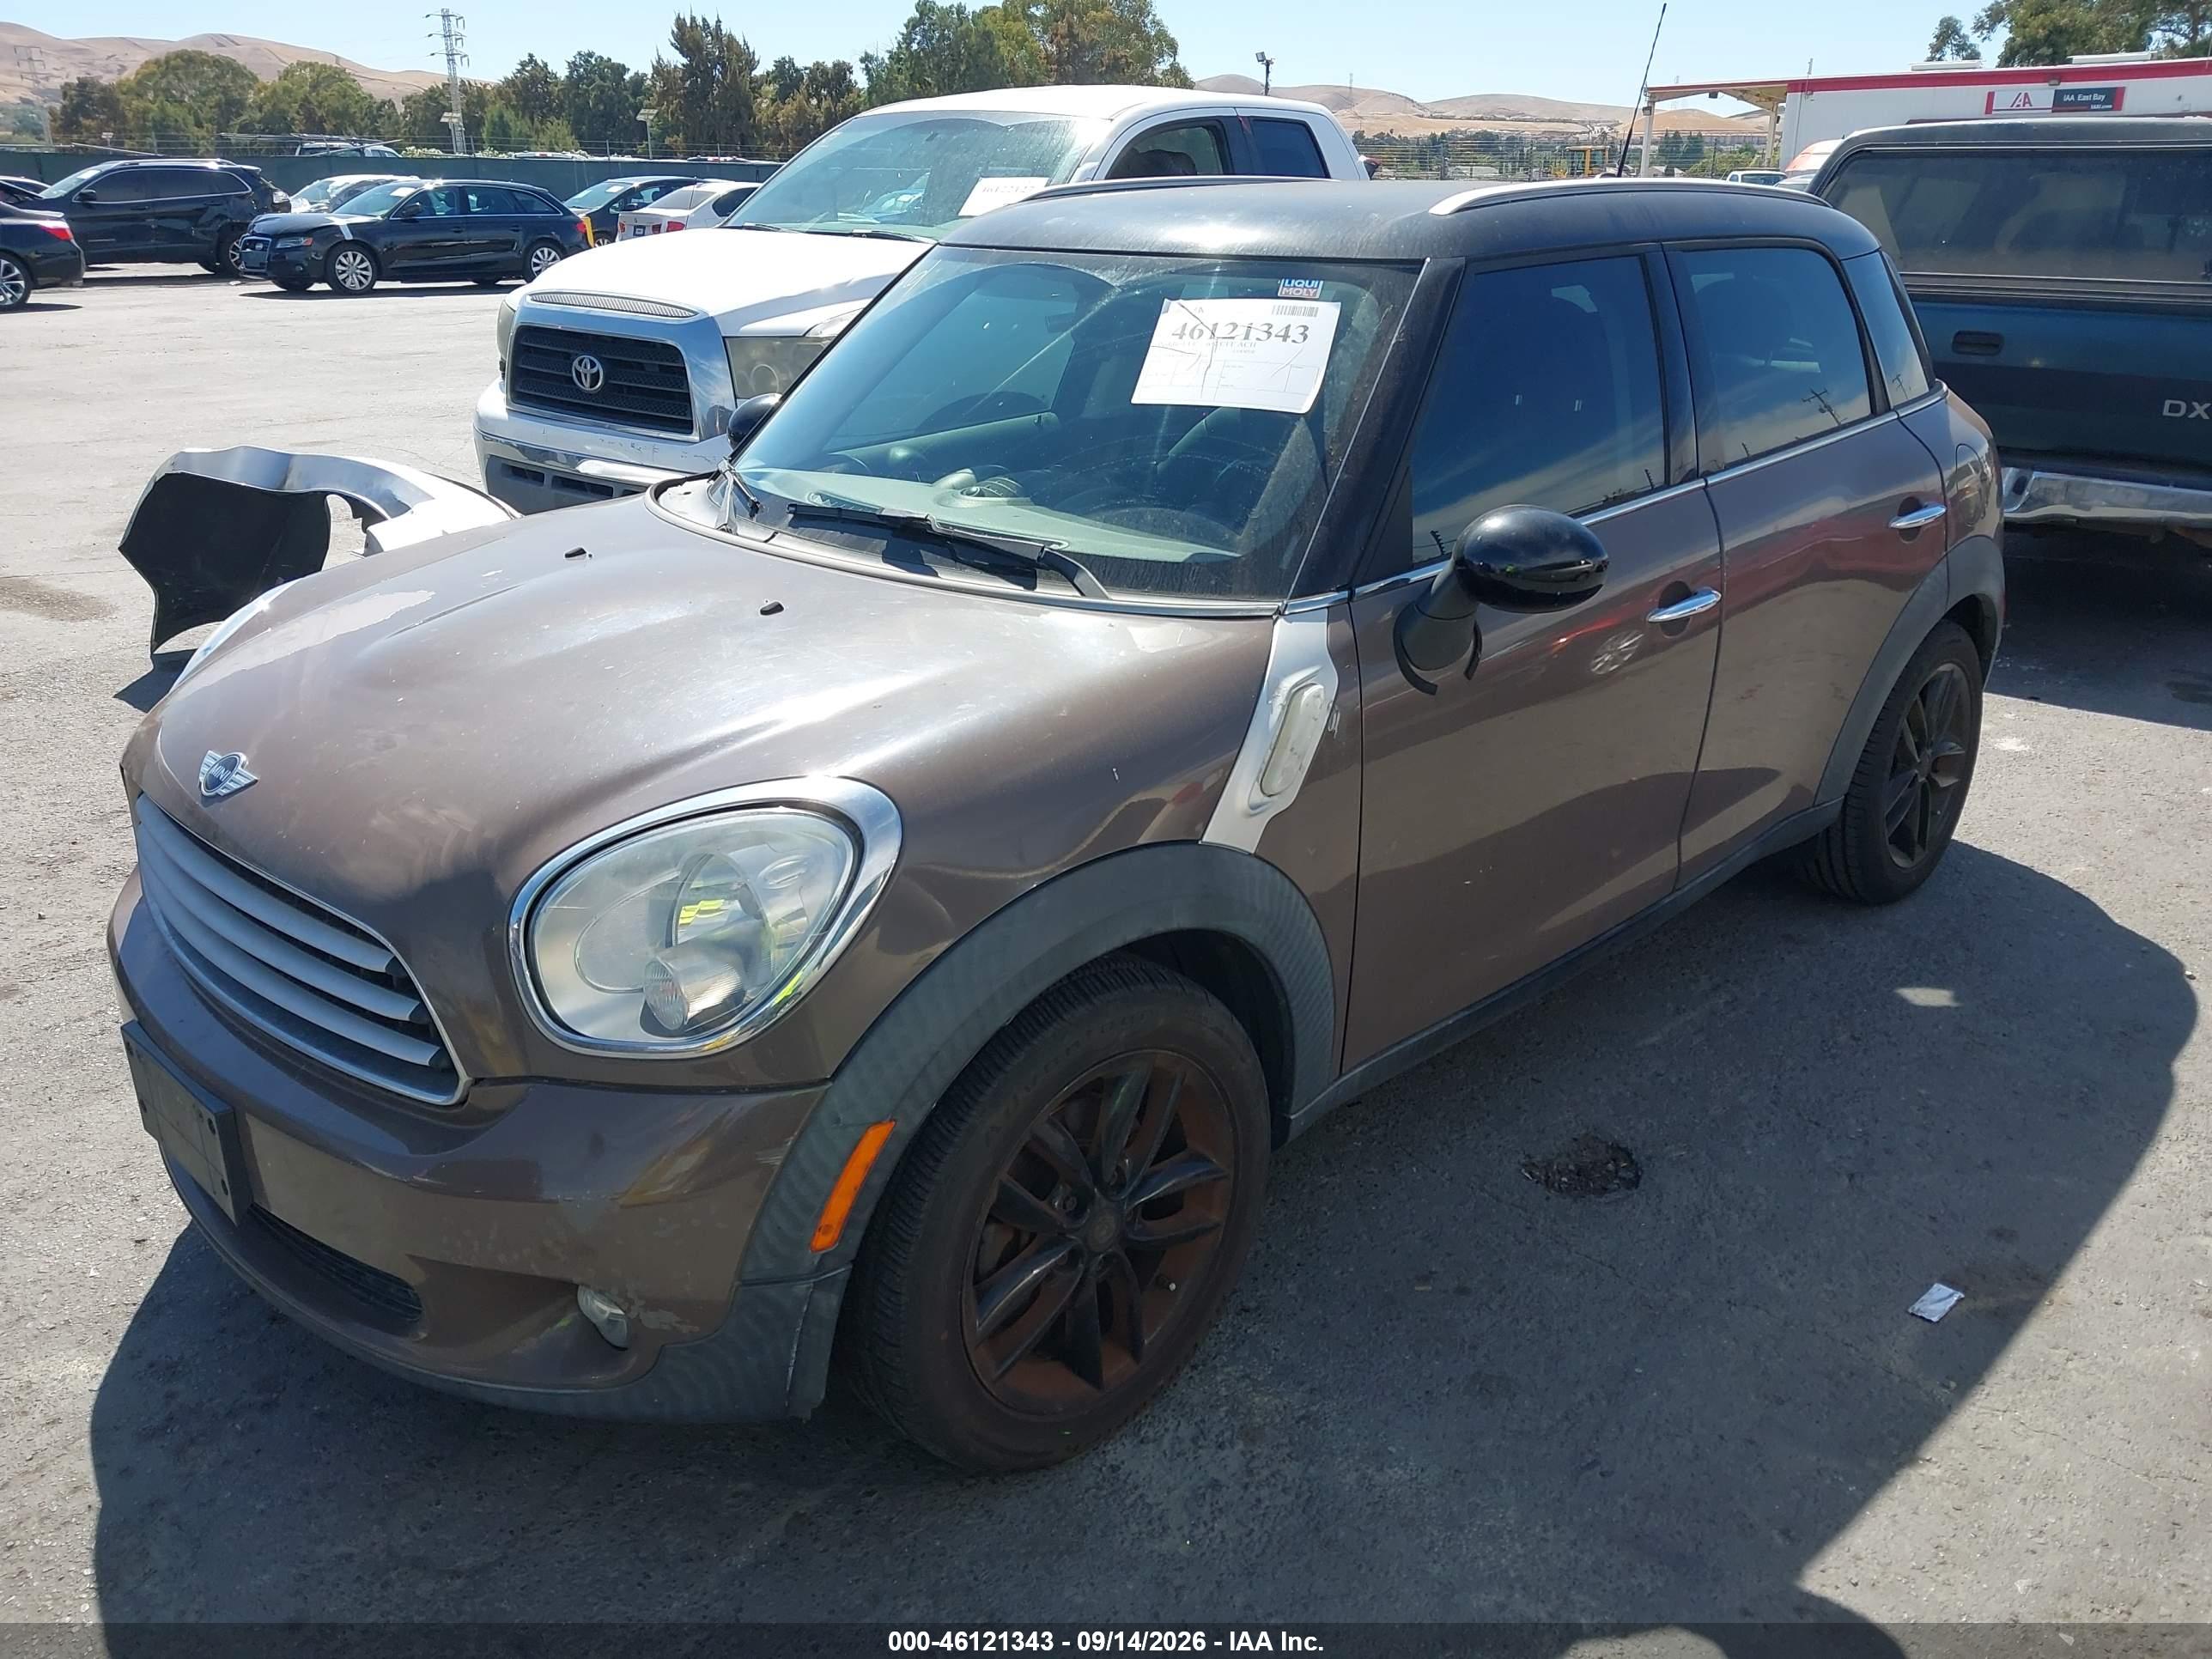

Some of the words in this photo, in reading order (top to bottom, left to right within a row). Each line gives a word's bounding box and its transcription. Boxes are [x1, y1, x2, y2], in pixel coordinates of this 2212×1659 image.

[1284, 278, 1319, 289] LIQUI
[1282, 287, 1317, 297] MOLY
[1171, 321, 1310, 344] 46121343
